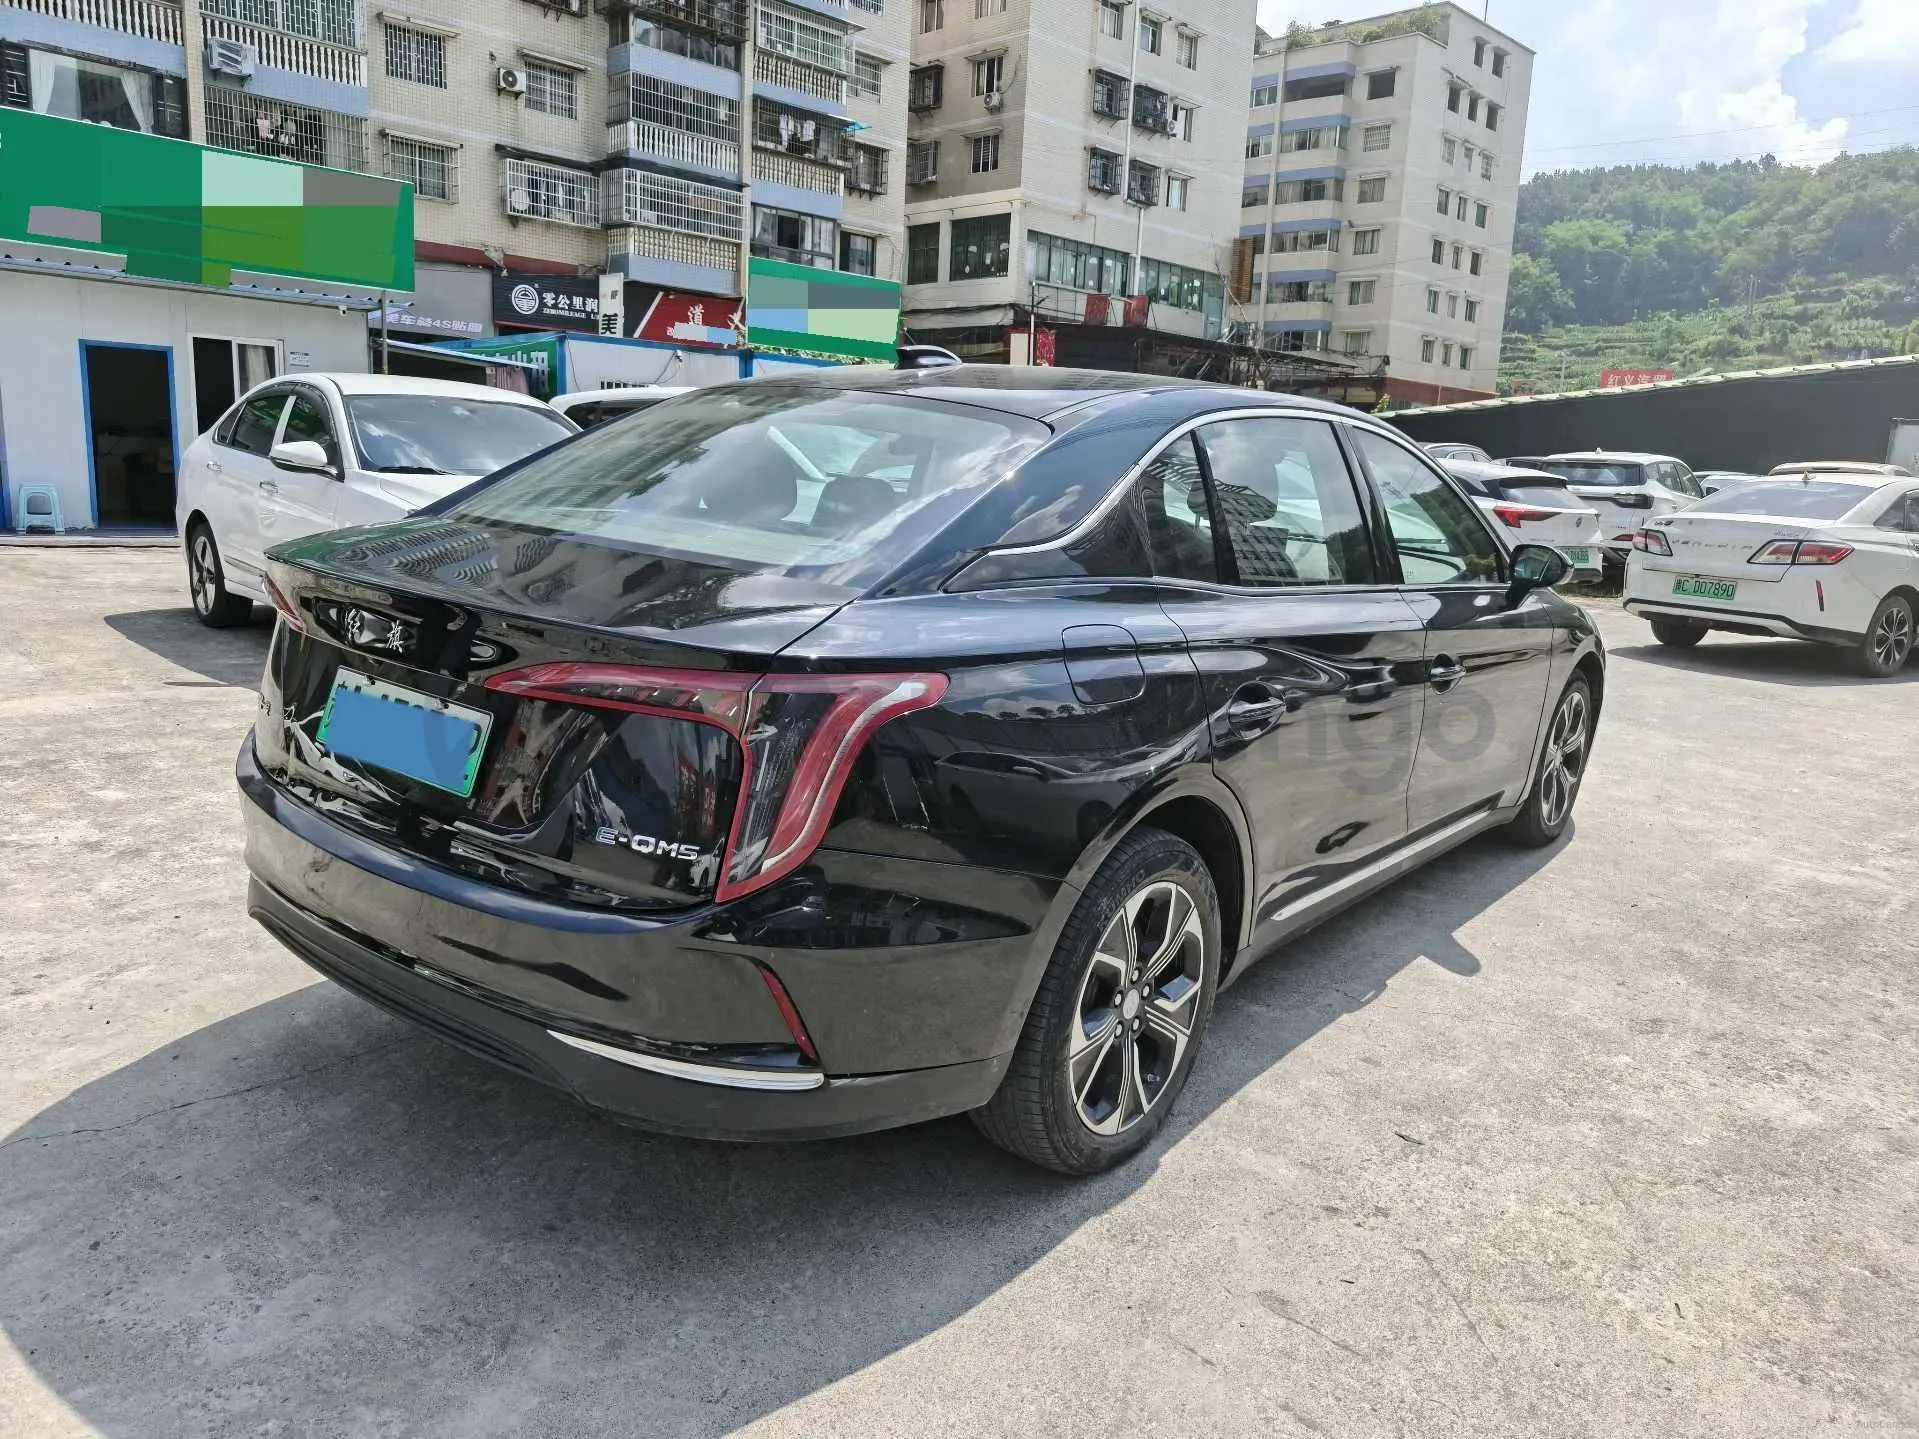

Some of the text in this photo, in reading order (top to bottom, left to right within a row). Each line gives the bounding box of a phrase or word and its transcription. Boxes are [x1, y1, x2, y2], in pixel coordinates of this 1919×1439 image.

[542, 292, 599, 313] 零公里润
[600, 313, 619, 335] 美
[1693, 579, 1735, 598] D07890
[595, 826, 701, 860] E-QM5
